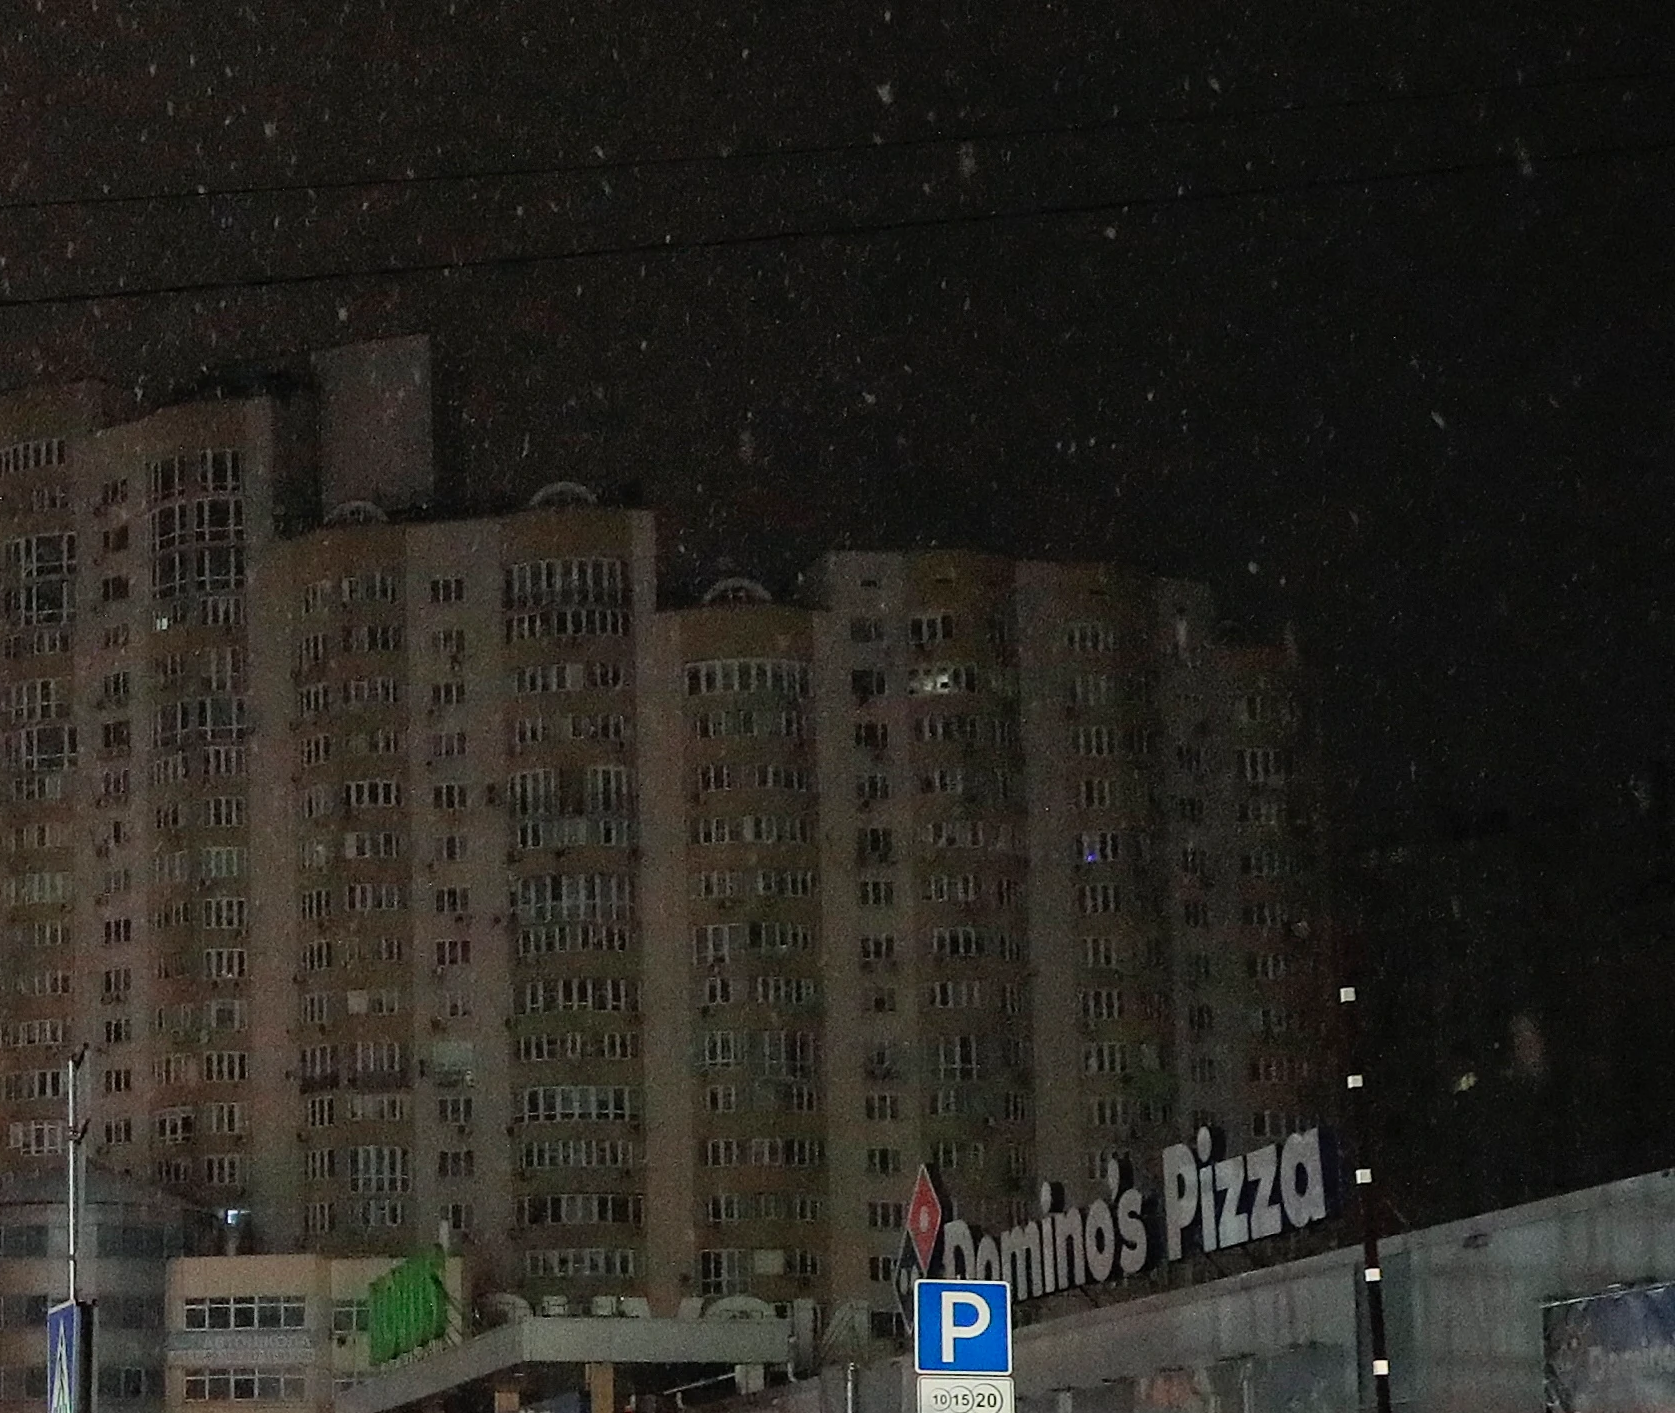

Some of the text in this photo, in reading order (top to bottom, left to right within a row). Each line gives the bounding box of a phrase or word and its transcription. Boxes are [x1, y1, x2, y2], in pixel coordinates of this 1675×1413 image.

[943, 1125, 1327, 1301] Domino's Pizza
[940, 1291, 992, 1364] P
[932, 1393, 997, 1408] 10 15 20
